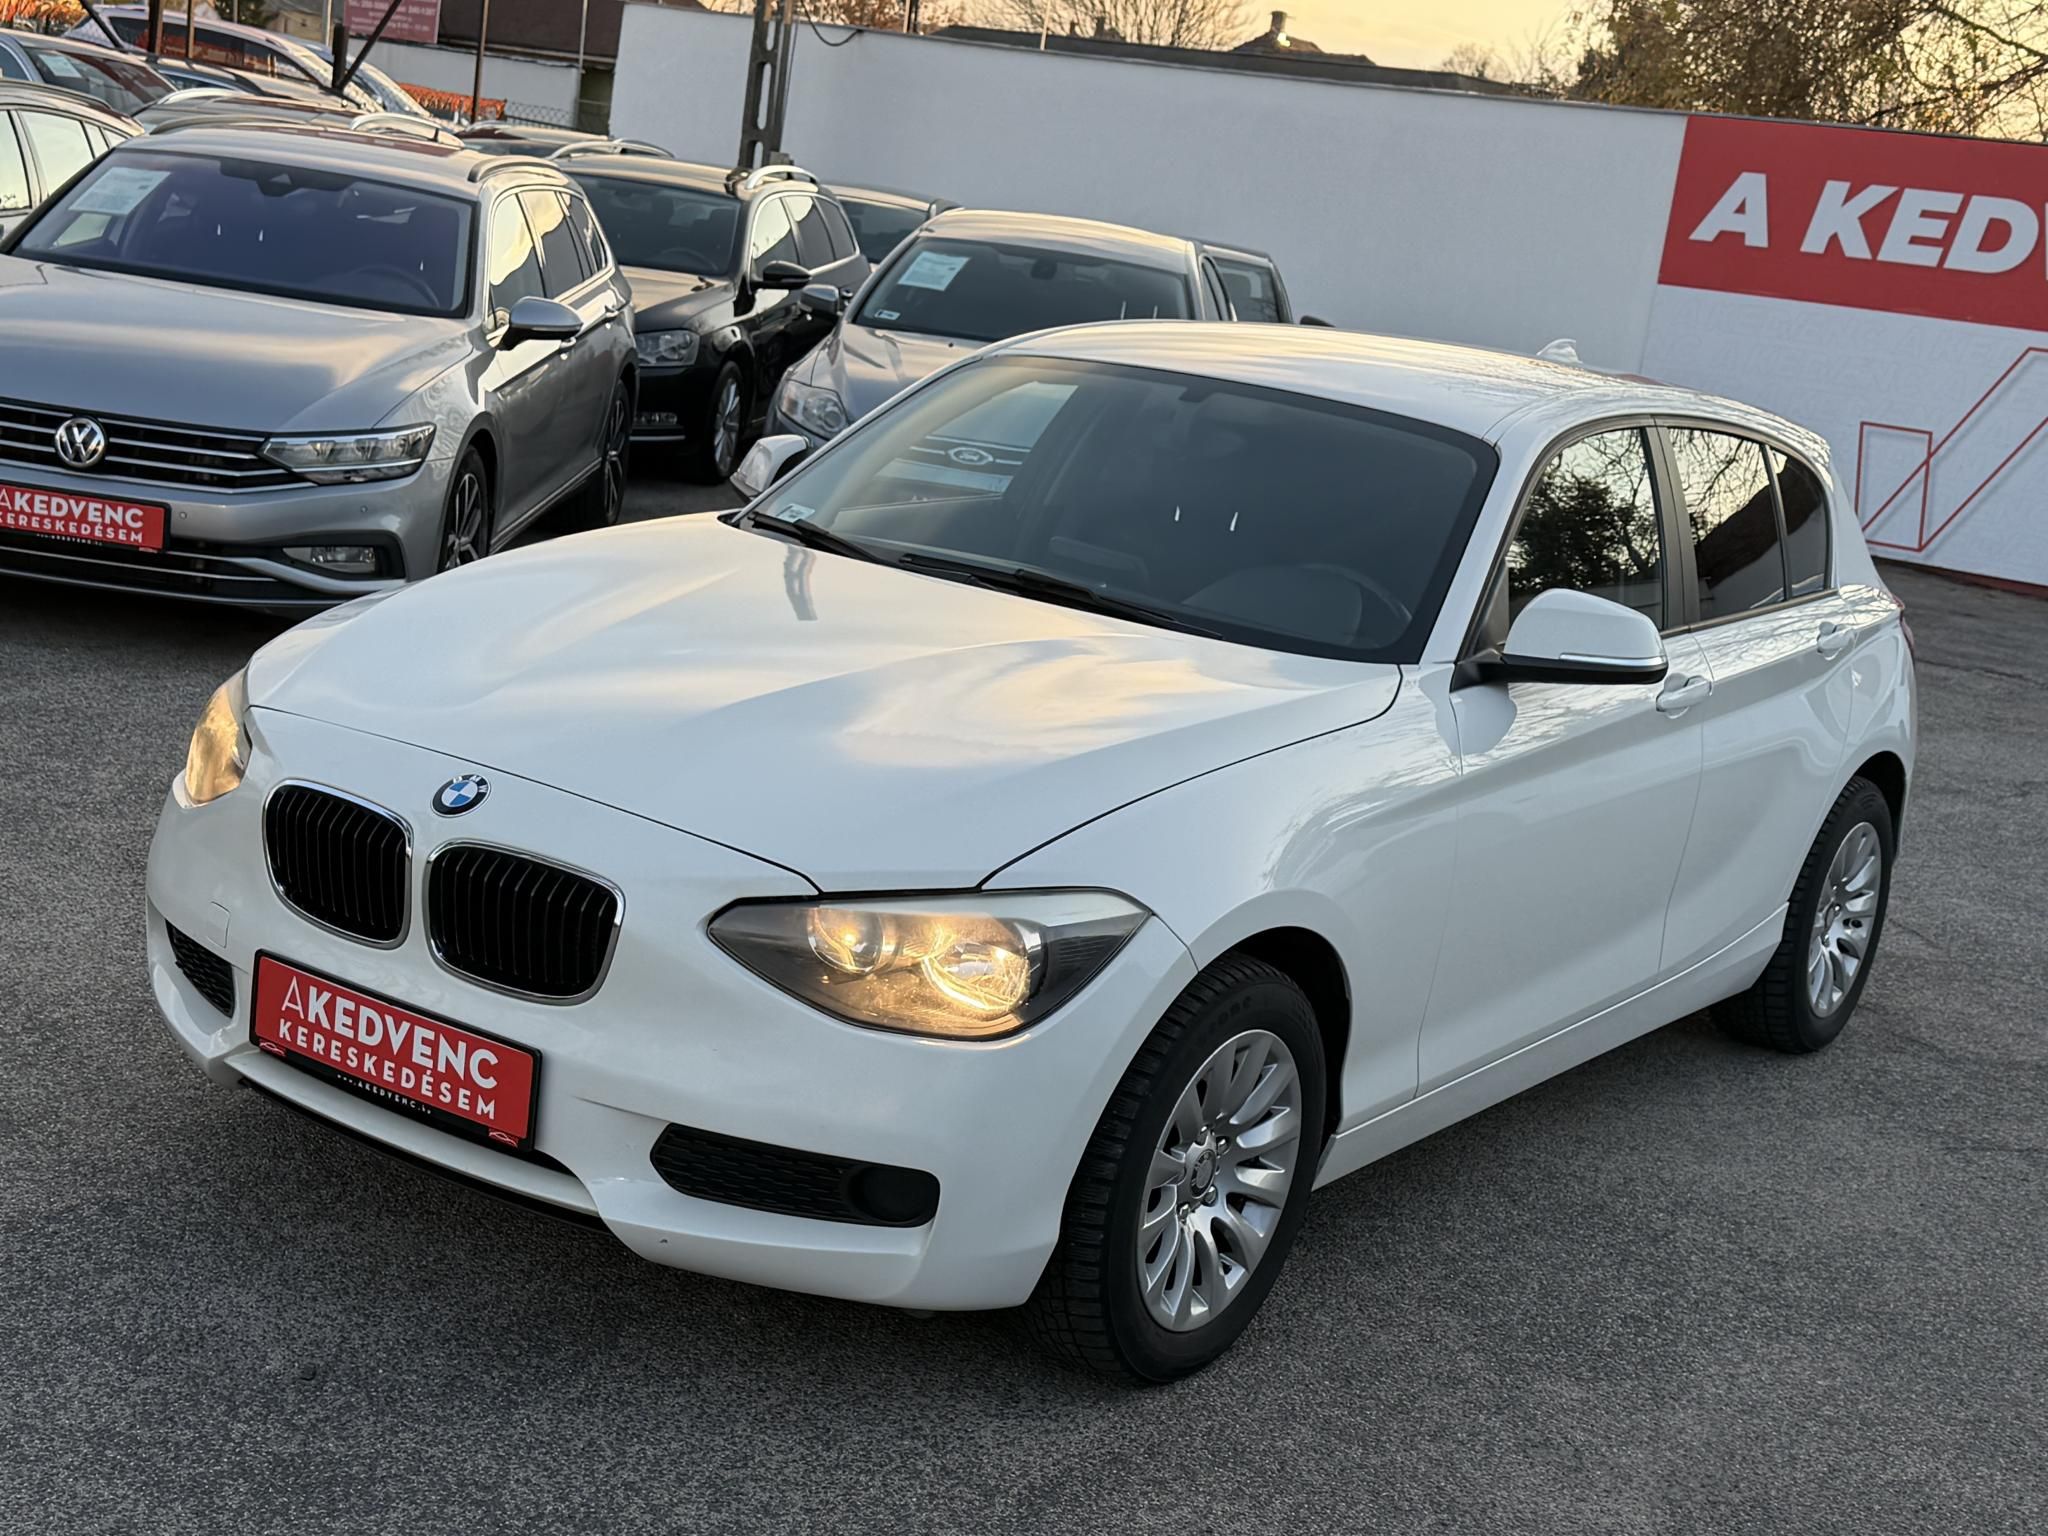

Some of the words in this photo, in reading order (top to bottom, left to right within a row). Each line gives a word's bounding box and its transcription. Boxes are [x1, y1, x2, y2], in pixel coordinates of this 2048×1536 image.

[1688, 171, 1769, 249] A
[1799, 179, 2048, 280] KED
[278, 1017, 496, 1121] KERESKEDÉSEM
